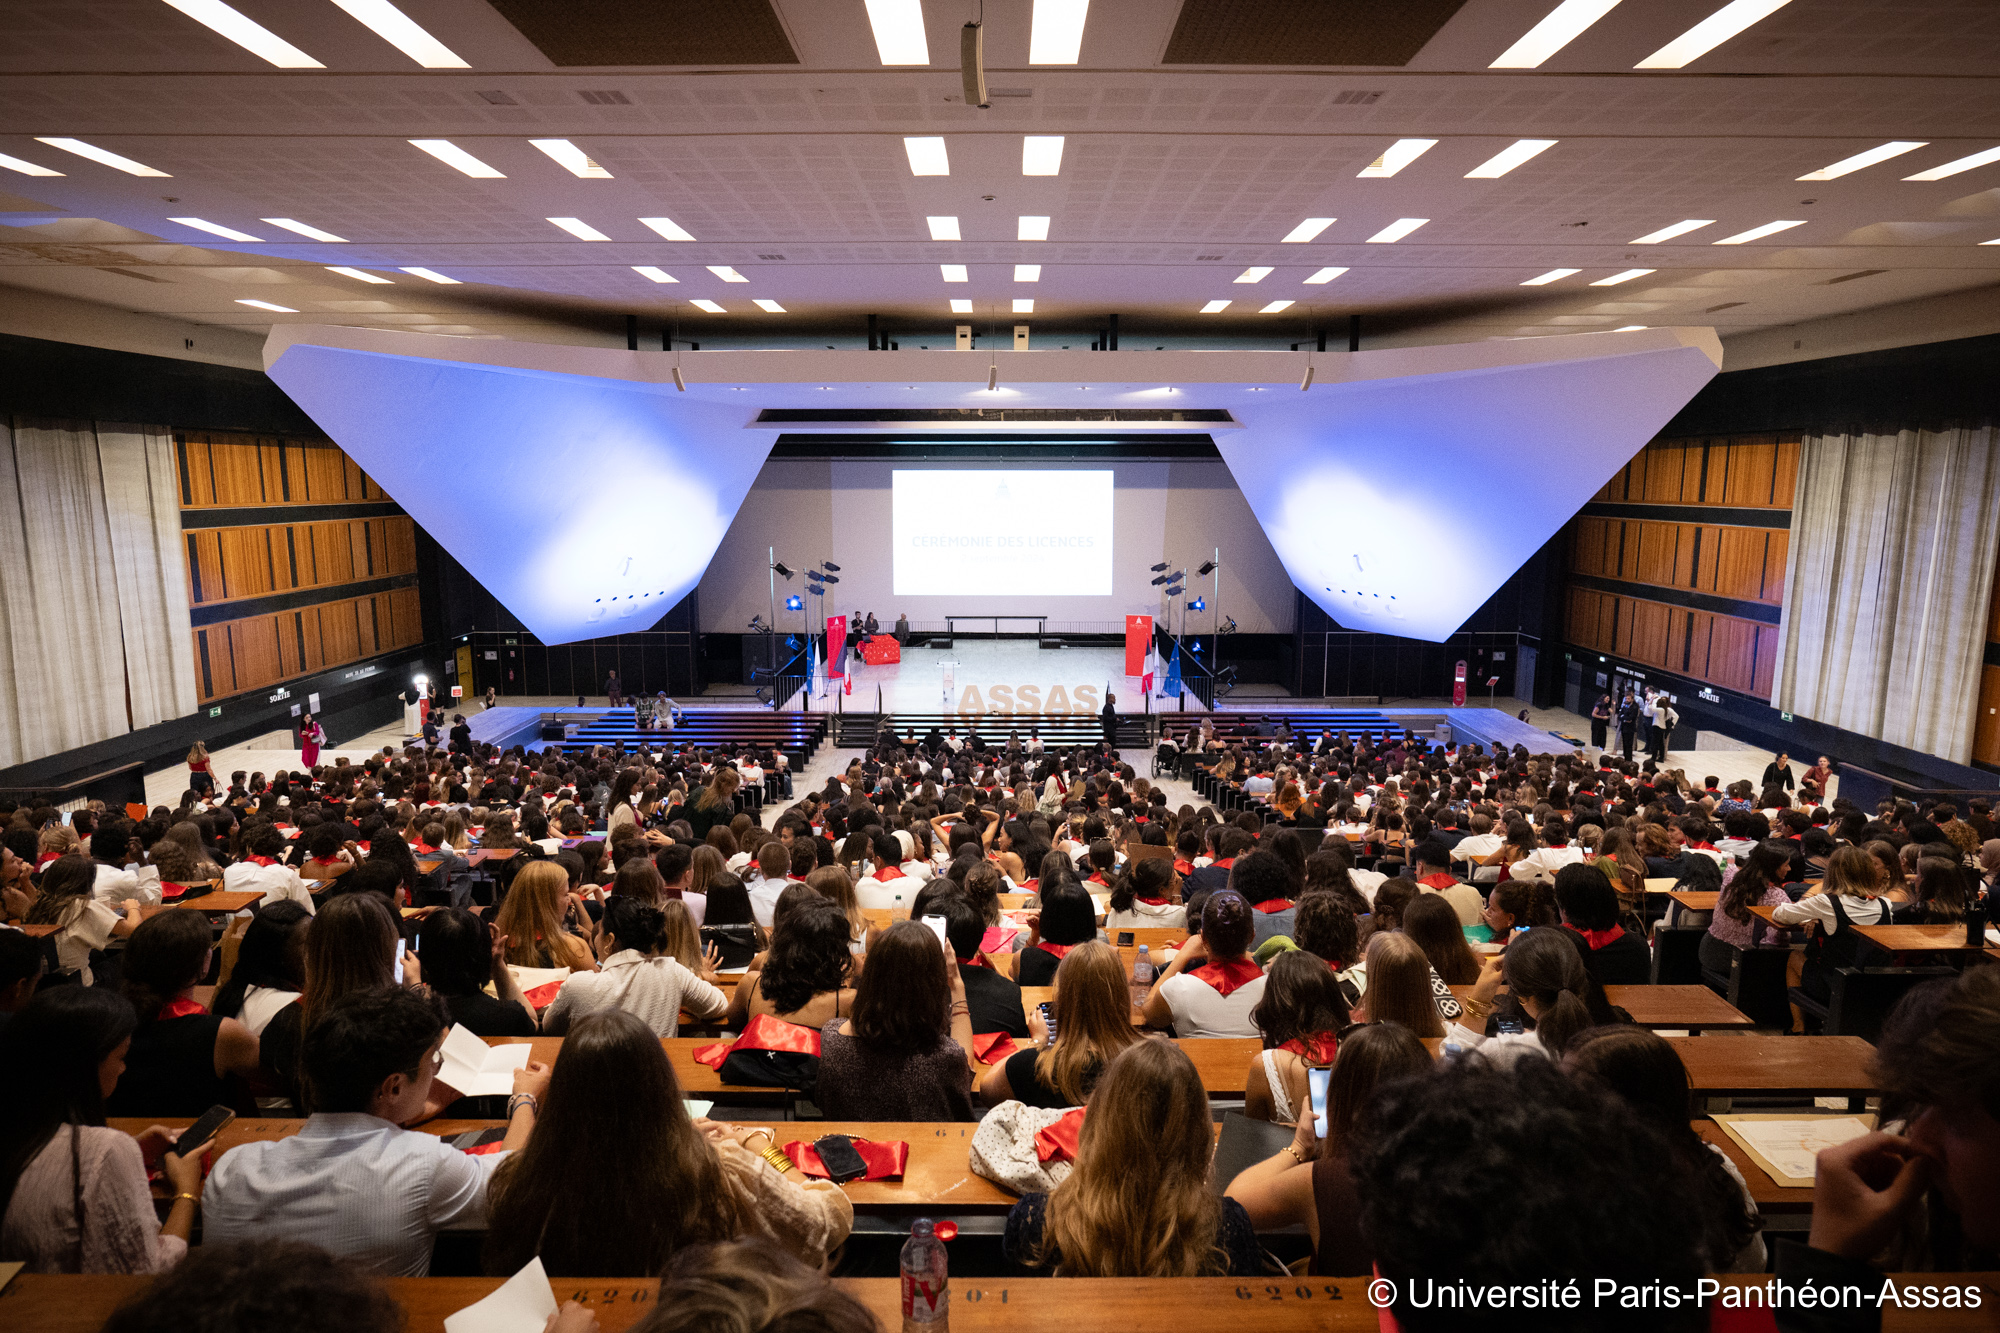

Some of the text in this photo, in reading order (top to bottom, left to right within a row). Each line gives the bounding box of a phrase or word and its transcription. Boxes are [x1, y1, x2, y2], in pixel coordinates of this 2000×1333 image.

[912, 534, 1094, 547] CÉRÉMONIE DES LICENCES
[269, 691, 290, 703] SORTIE
[957, 685, 1099, 714] ASSAS
[1698, 691, 1720, 703] SORTIE
[947, 1288, 1008, 1304] 01
[1235, 1285, 1344, 1300] 6202
